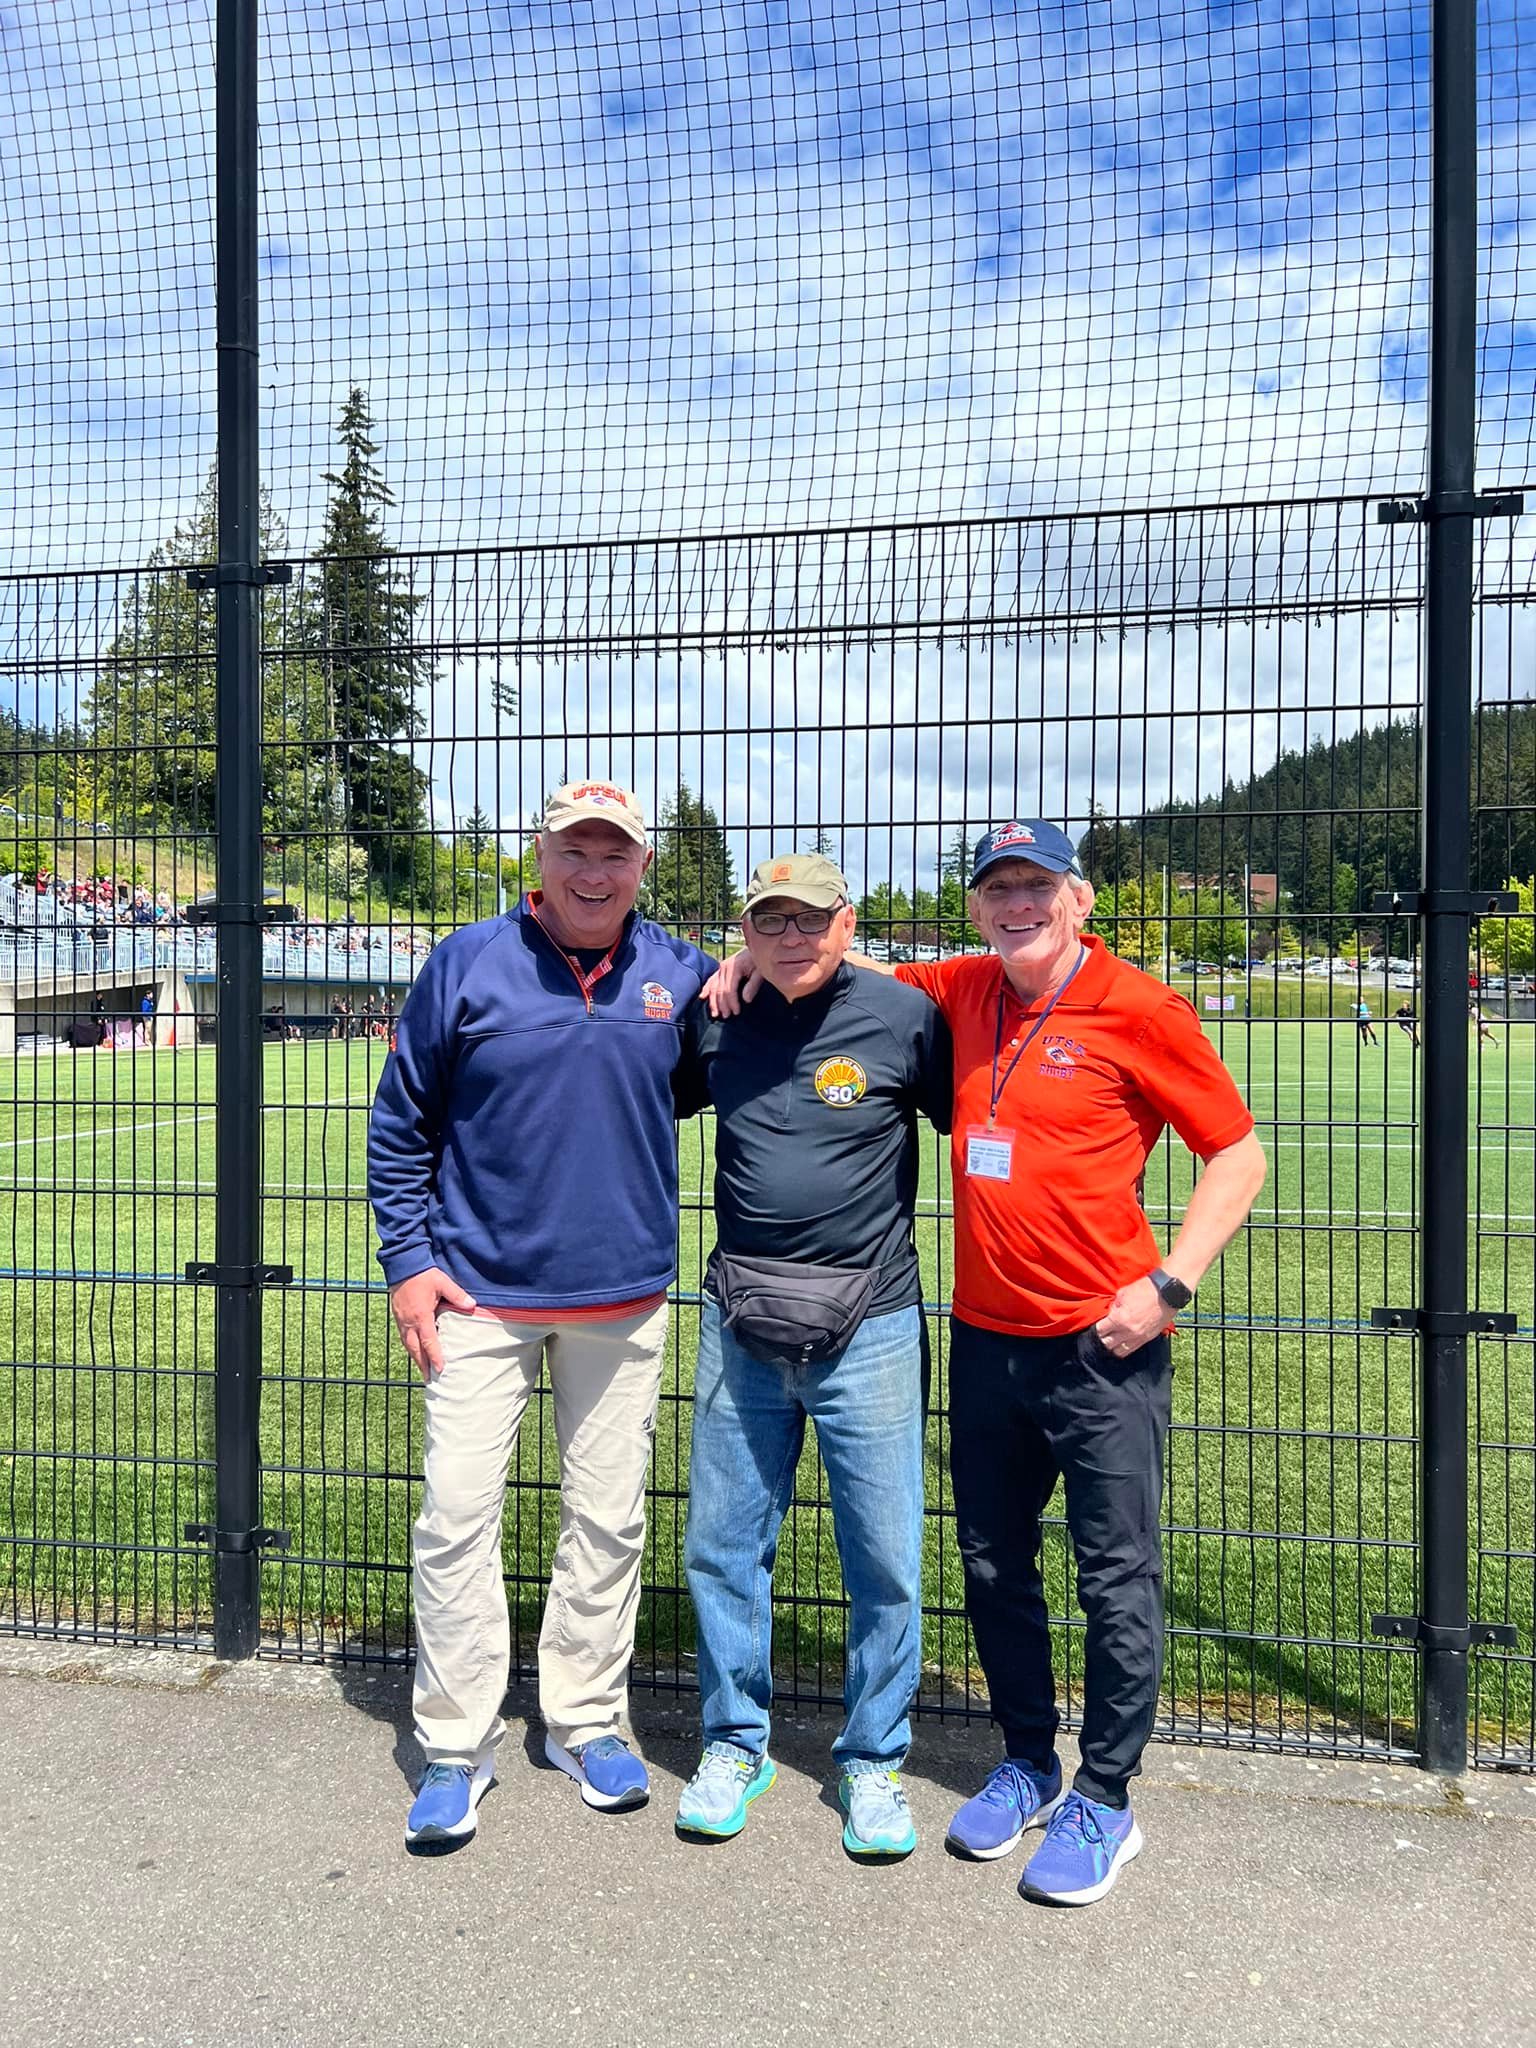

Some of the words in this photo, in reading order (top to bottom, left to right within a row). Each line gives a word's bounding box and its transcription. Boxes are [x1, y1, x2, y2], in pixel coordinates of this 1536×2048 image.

[645, 1007, 672, 1020] RUGBY
[1042, 1035, 1085, 1058] UTSA
[828, 1085, 853, 1103] 50
